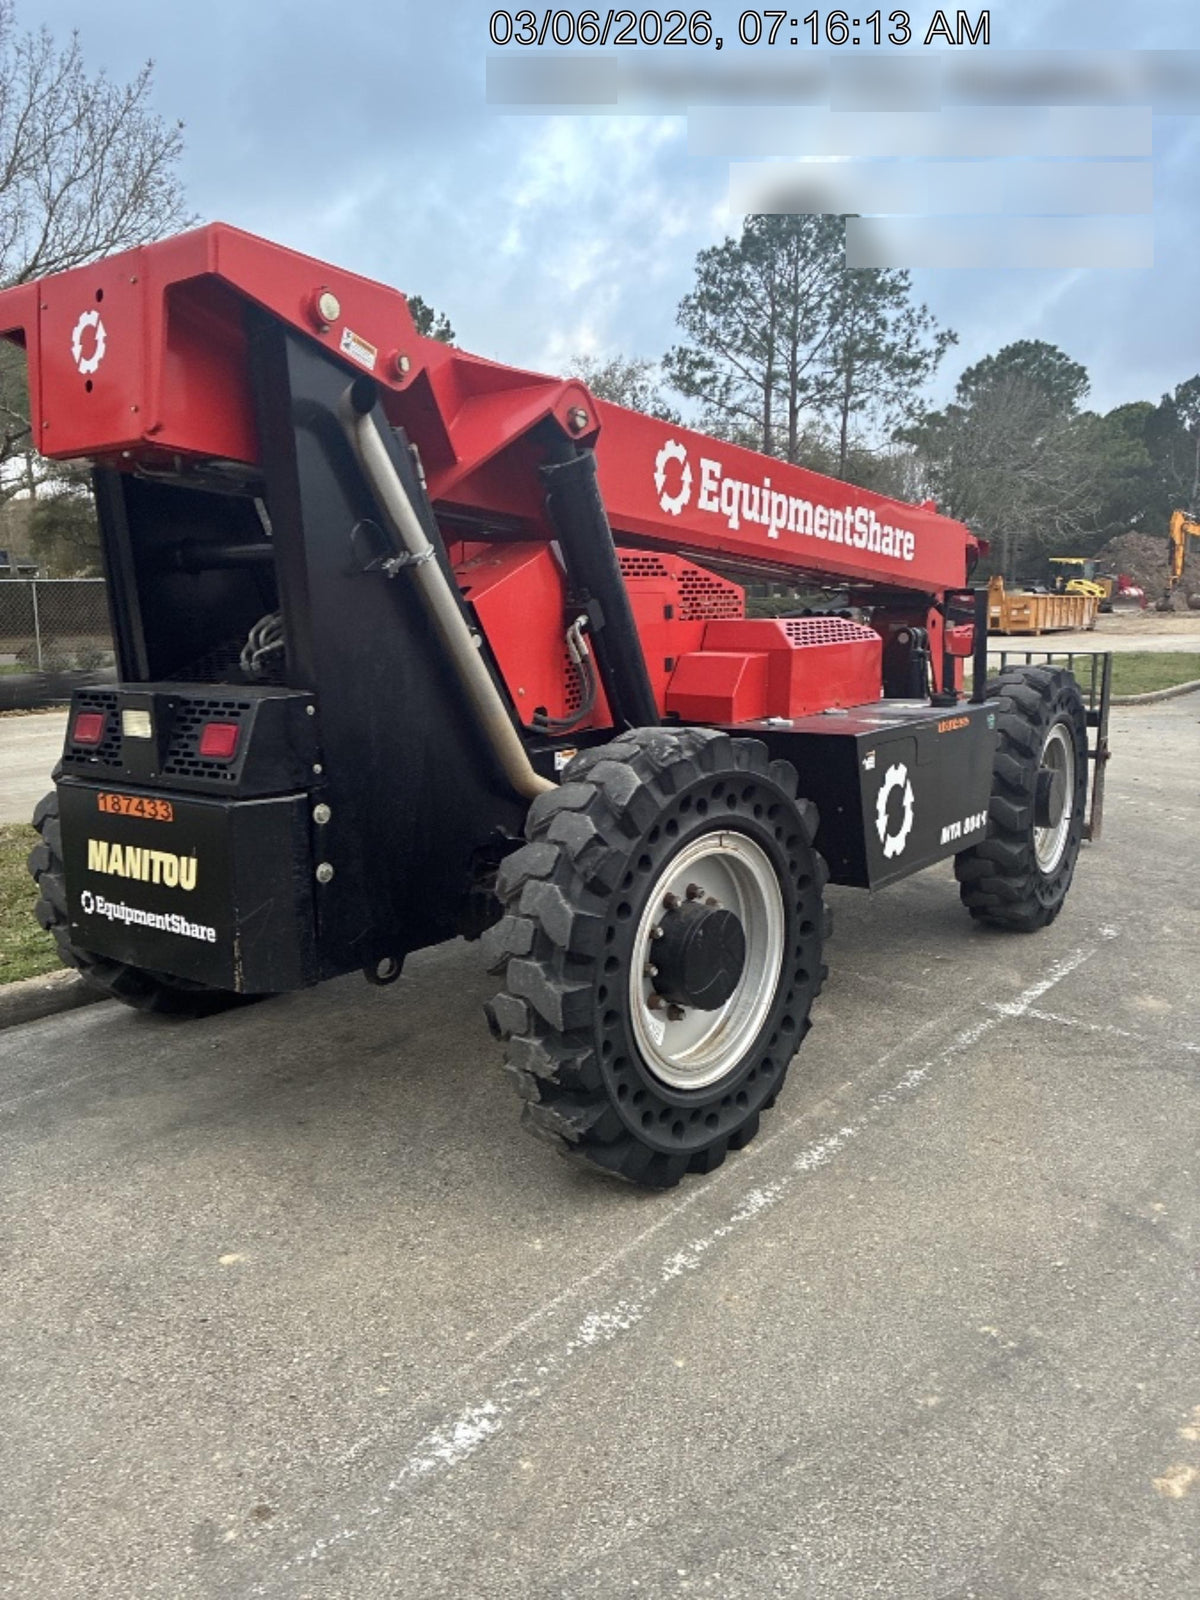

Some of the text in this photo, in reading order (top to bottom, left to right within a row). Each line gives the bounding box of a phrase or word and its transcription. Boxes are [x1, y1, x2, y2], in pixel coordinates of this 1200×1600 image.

[698, 457, 915, 561] EquipmentShare
[99, 795, 172, 821] 187433
[87, 838, 198, 891] MANITOU
[95, 895, 217, 943] EquipmentShare
